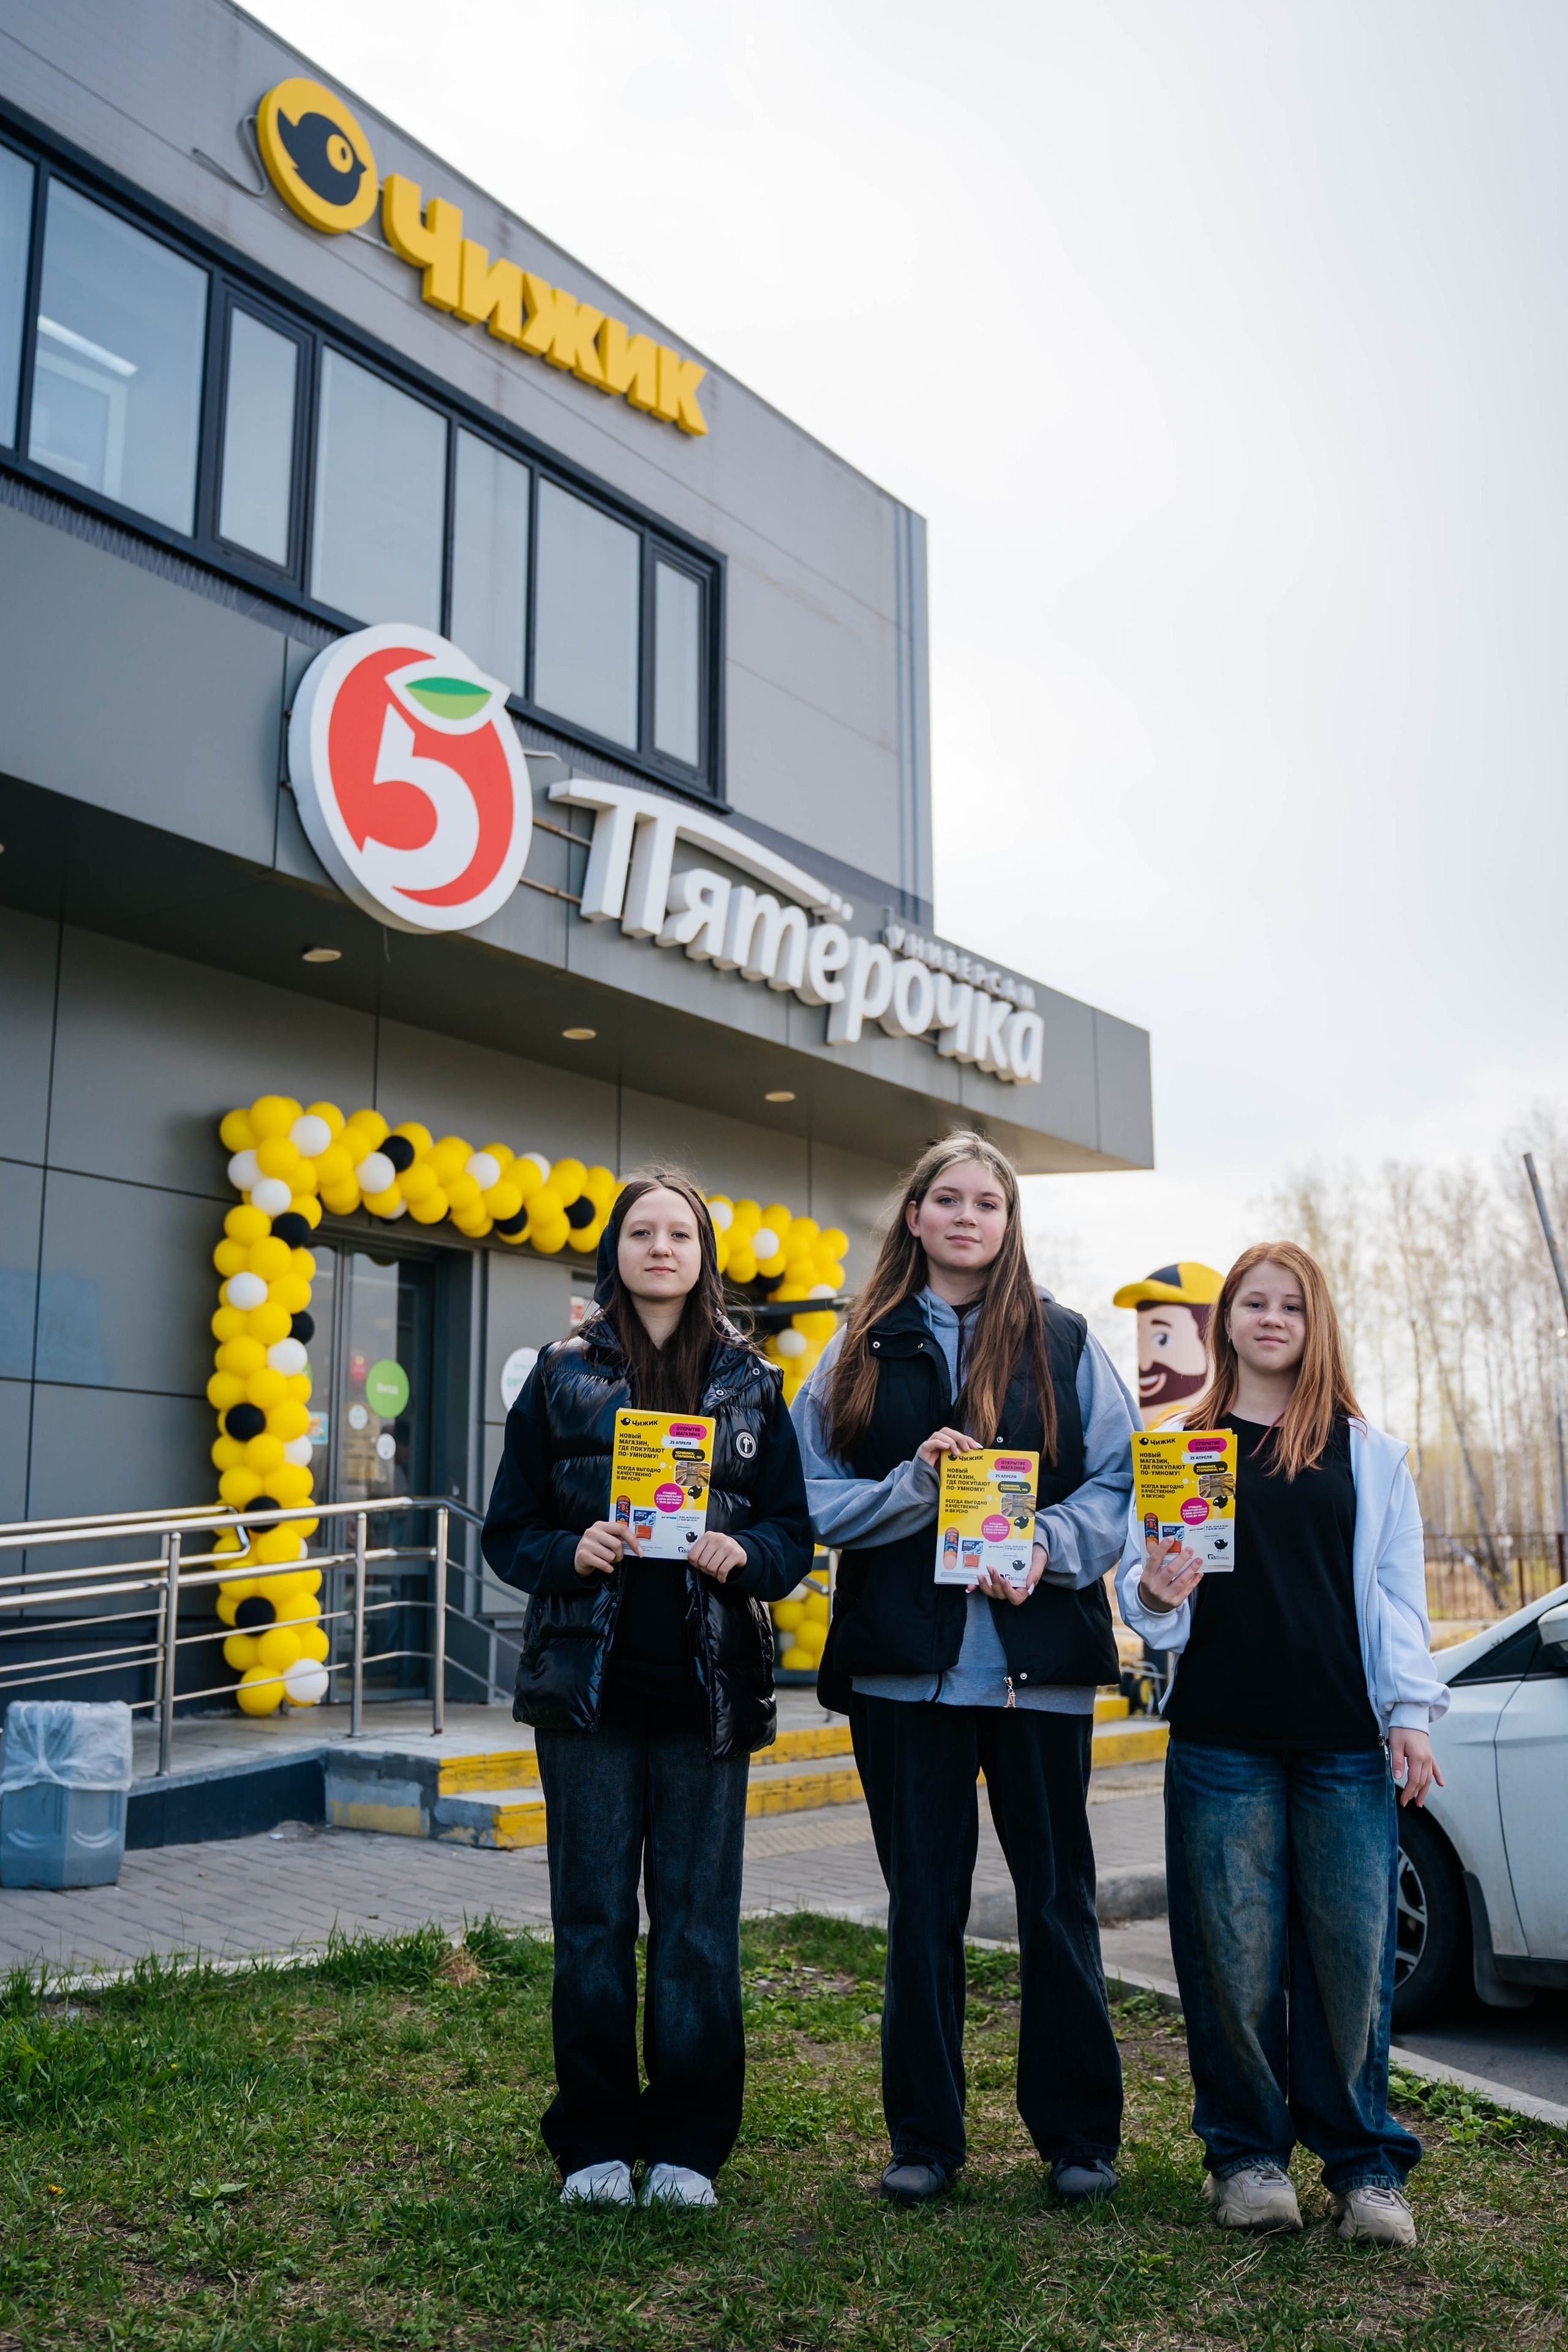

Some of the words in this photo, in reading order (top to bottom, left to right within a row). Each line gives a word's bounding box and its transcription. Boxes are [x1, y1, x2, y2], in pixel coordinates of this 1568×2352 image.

[383, 173, 709, 436] Чижик
[364, 703, 480, 891] 5
[548, 778, 1044, 1085] Пятёрочка
